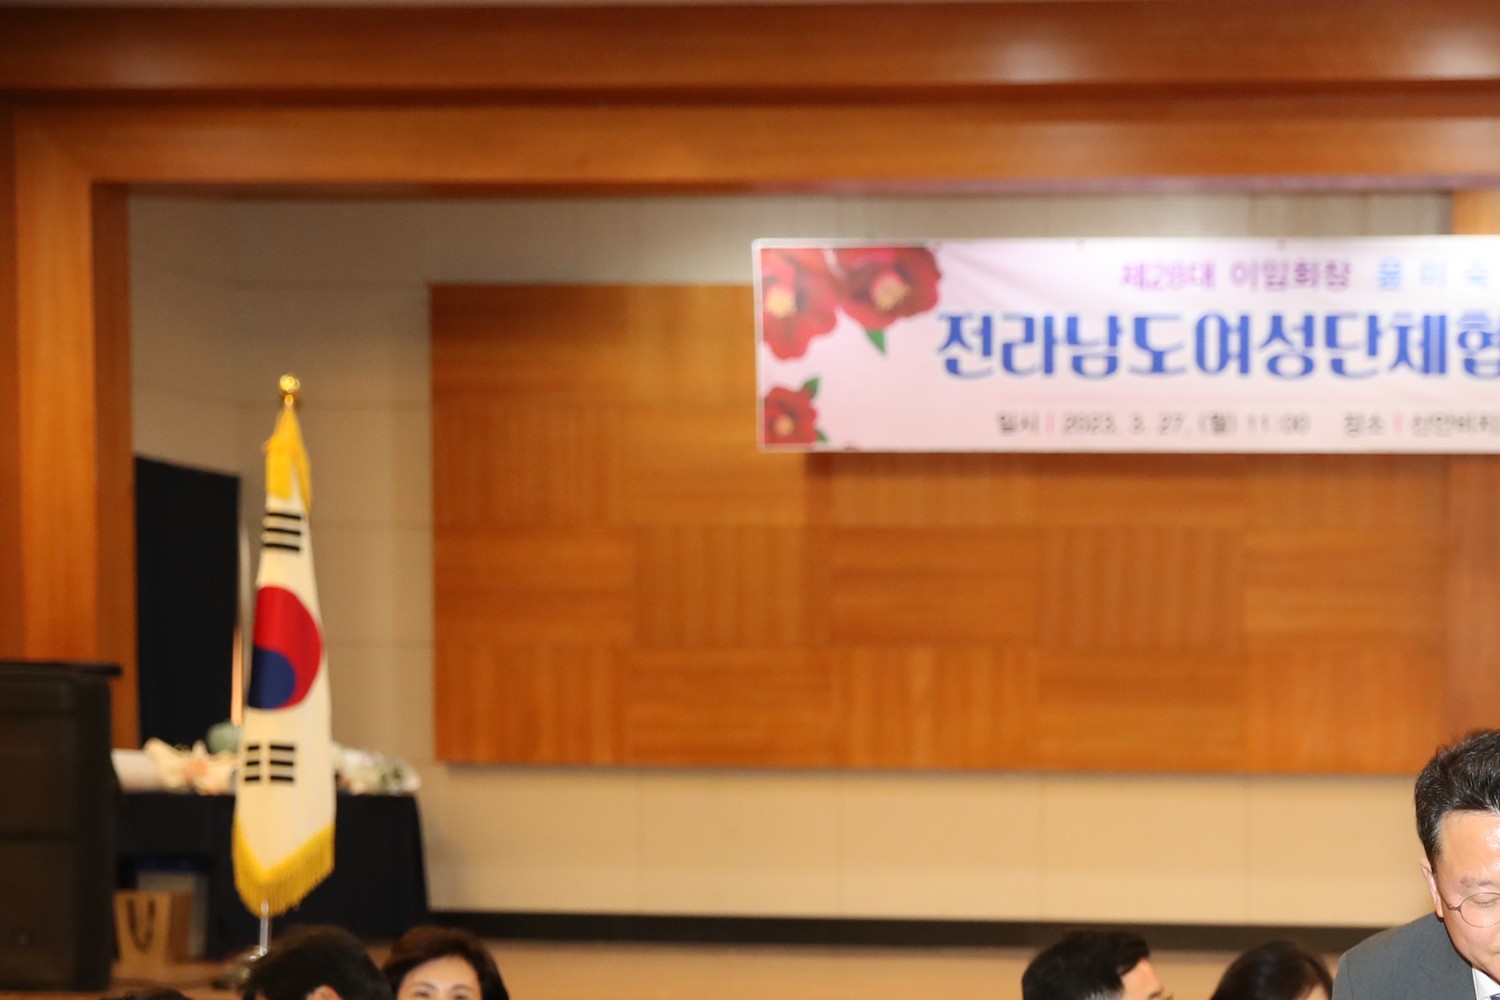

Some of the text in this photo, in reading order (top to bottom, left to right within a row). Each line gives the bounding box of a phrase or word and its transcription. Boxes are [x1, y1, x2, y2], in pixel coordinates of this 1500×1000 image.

[1120, 261, 1215, 290] 제28대
[1229, 259, 1353, 290] 이임회장
[996, 411, 1040, 435] 일시
[1246, 413, 1310, 434] 11:00
[1342, 411, 1386, 436] 장소
